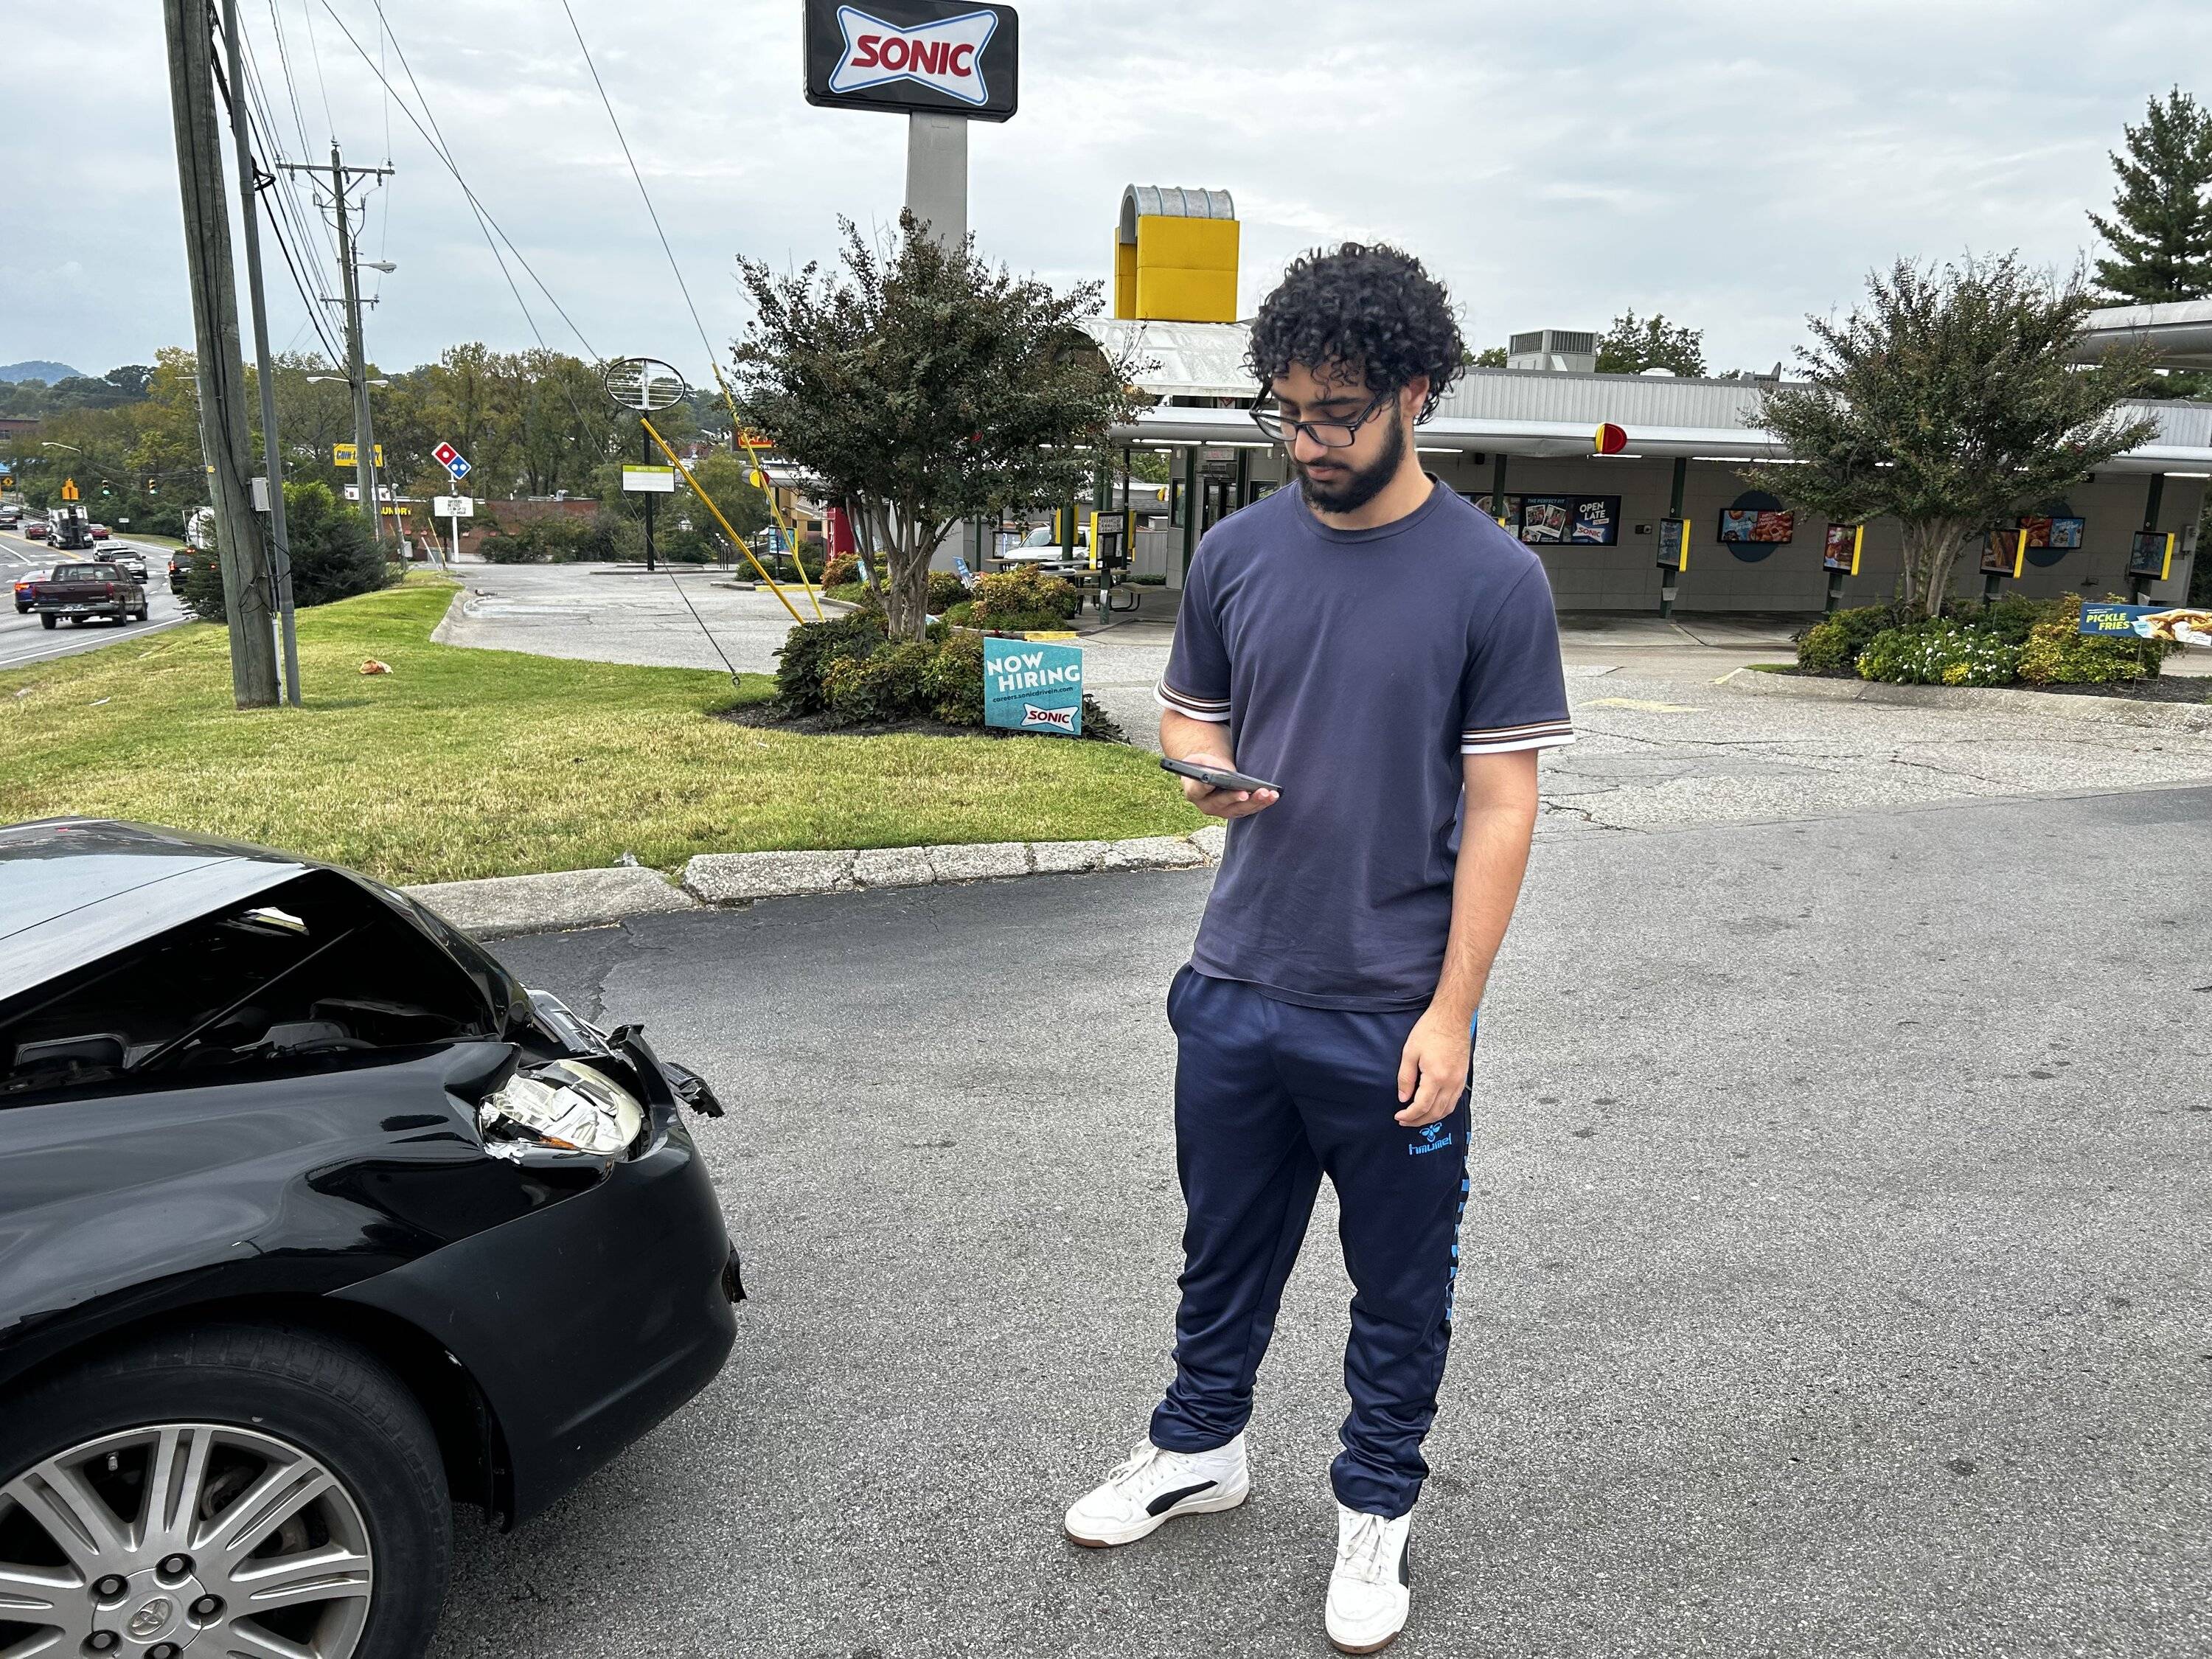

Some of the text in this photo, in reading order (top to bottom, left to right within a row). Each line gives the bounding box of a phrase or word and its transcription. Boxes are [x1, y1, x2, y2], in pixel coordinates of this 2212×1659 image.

[850, 35, 974, 77] SONIC
[1579, 501, 1604, 513] OPEN
[1585, 510, 1606, 521] LATE
[1577, 526, 1601, 538] SONIC
[2086, 613, 2126, 623] PICKLE
[2098, 621, 2130, 630] FRIES
[987, 652, 1044, 676] NOW
[998, 665, 1080, 692] HIRING
[992, 686, 1074, 703] careers.sonicdrivein.com
[1028, 711, 1071, 723] SONIC
